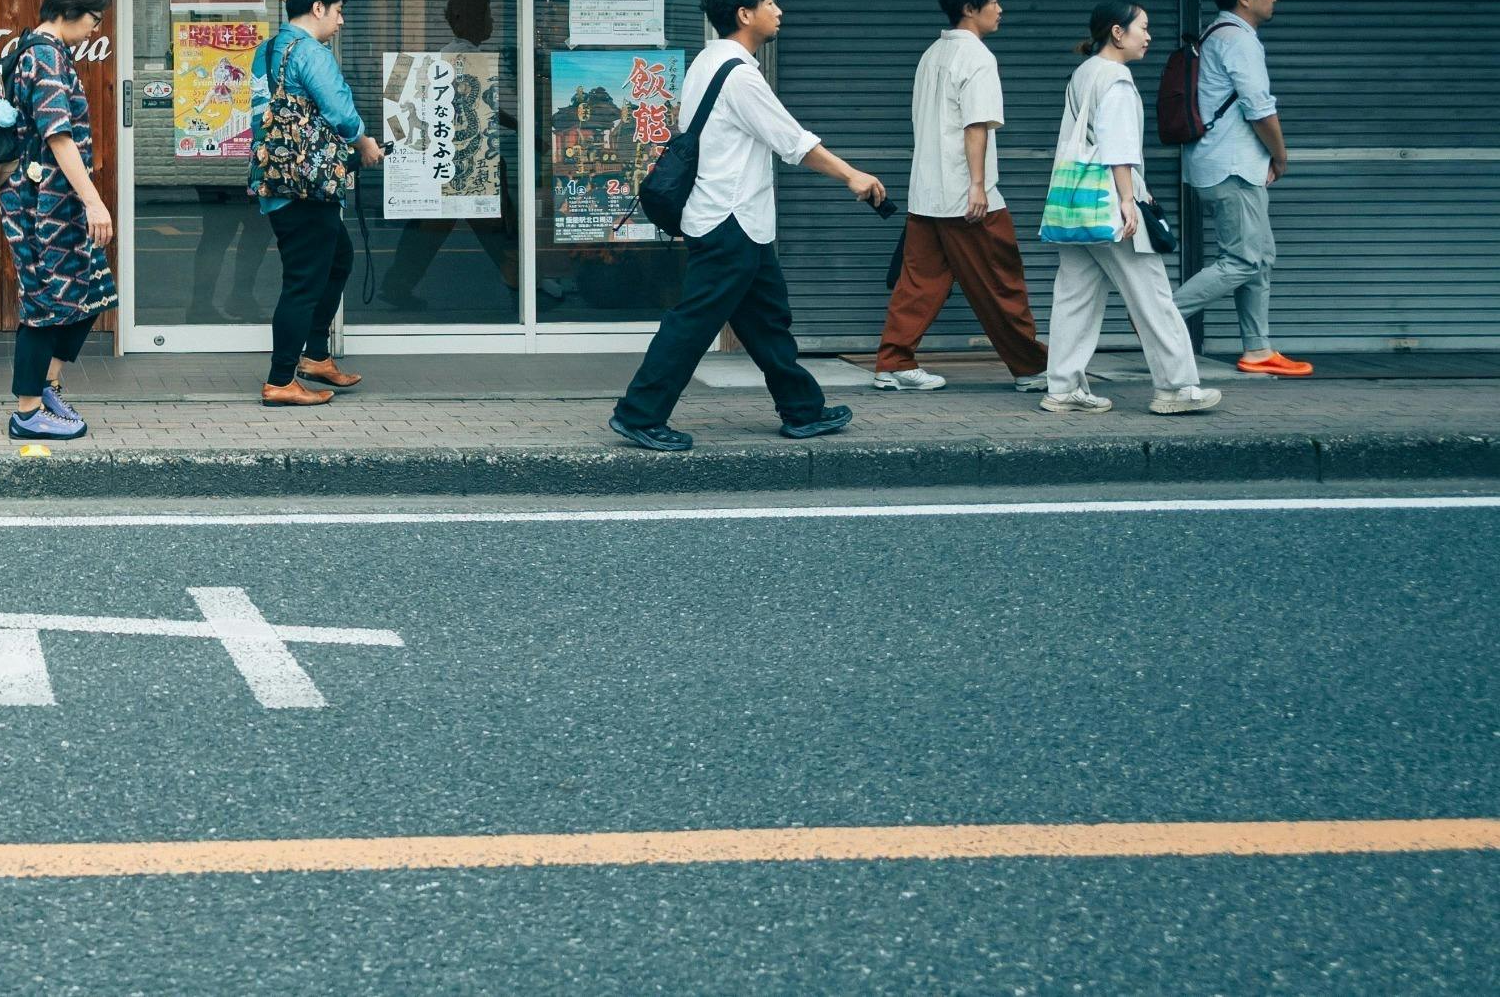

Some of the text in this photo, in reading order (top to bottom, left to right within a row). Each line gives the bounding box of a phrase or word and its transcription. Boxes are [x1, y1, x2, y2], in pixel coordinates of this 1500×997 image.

[433, 65, 452, 180] レアなおふだ
